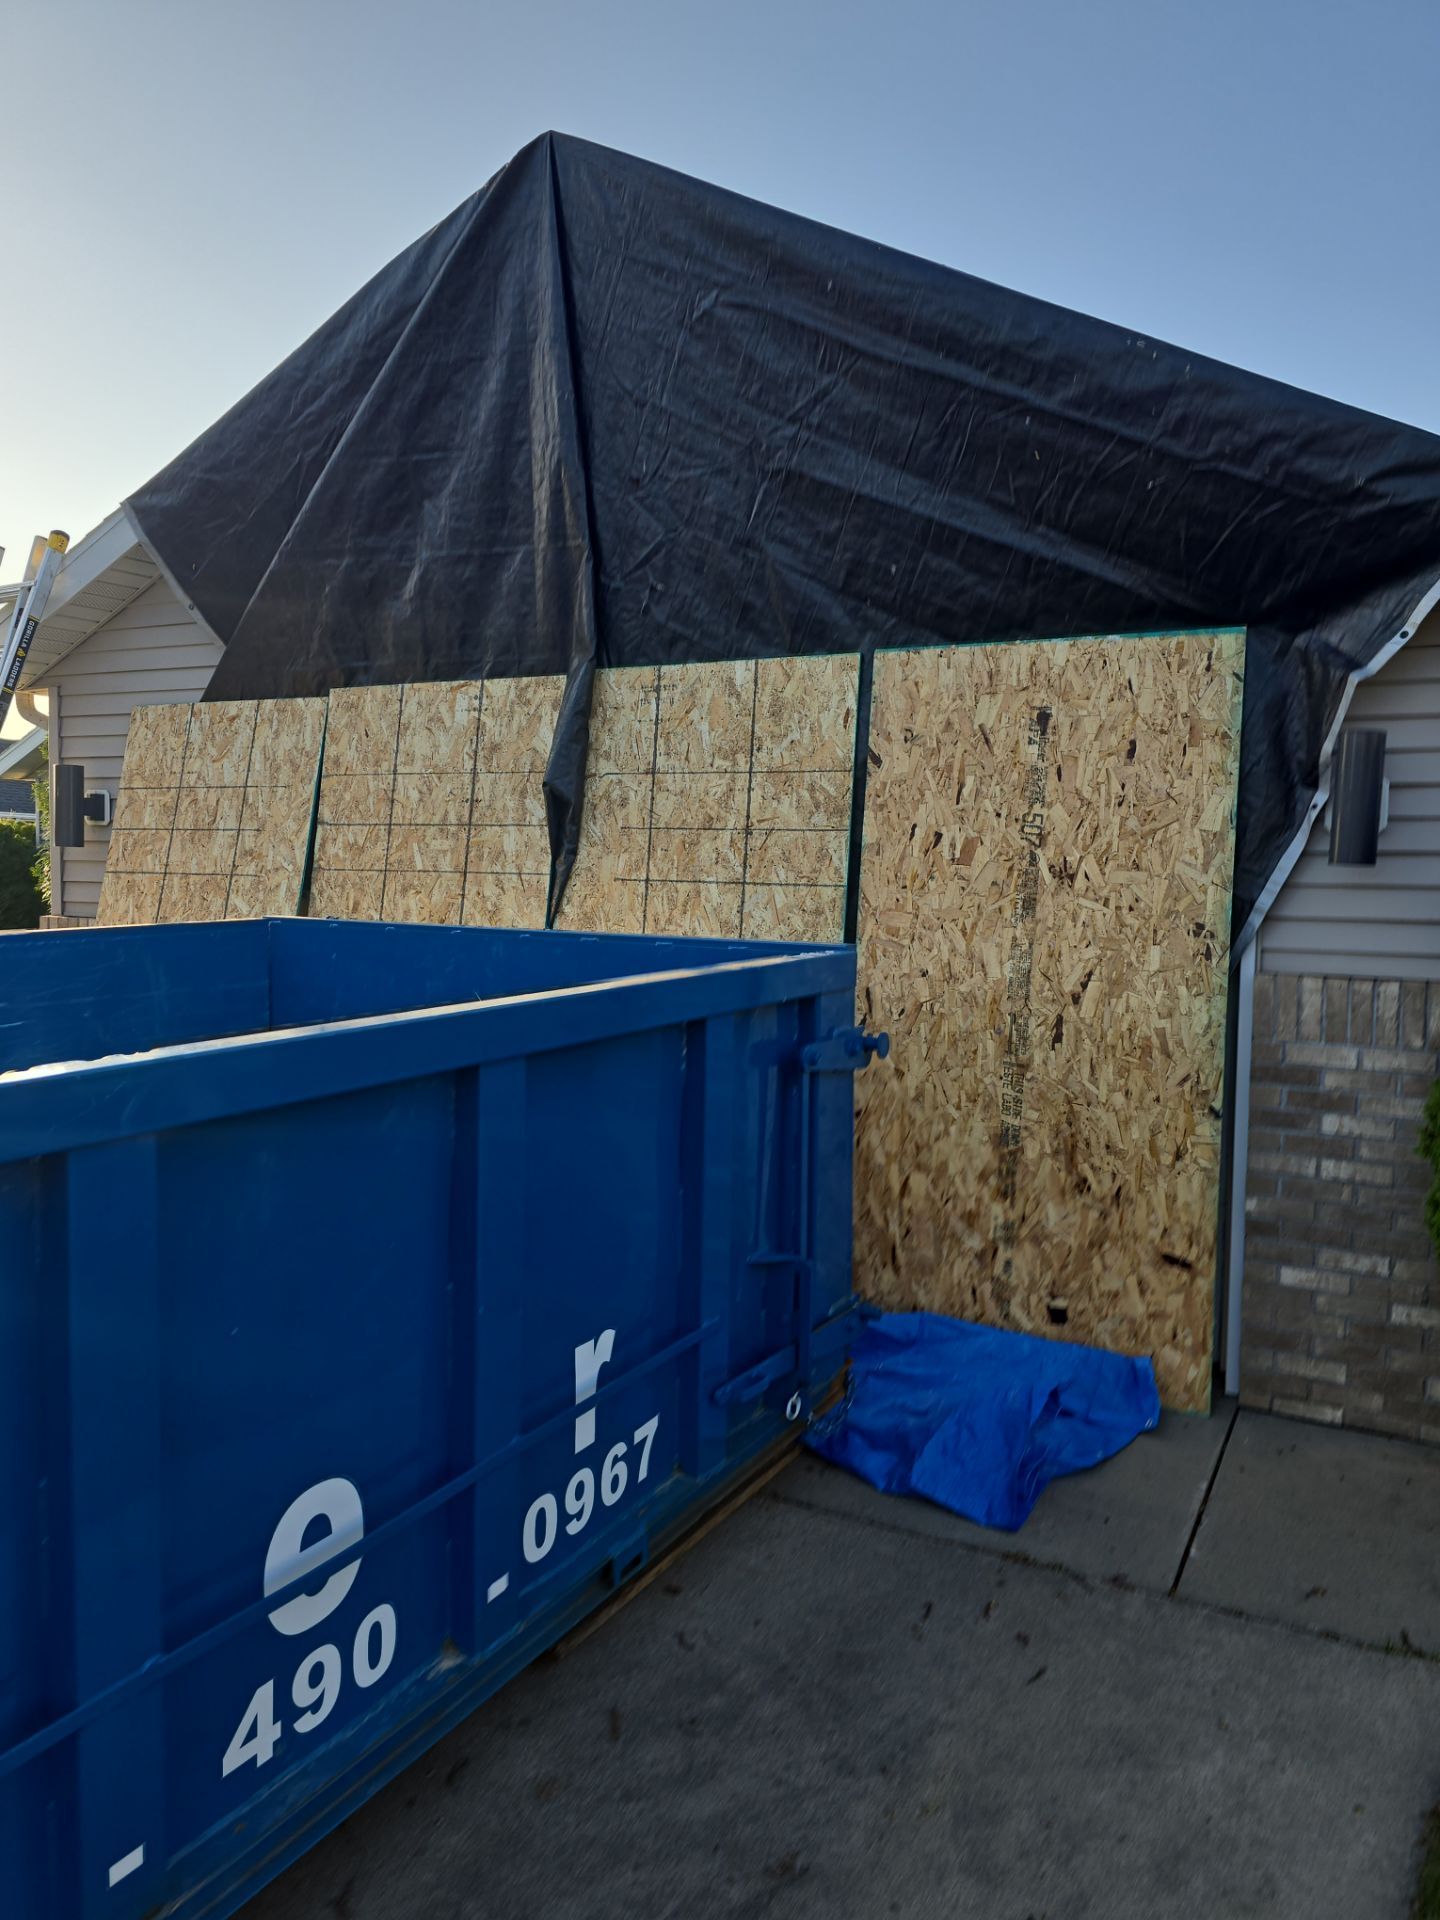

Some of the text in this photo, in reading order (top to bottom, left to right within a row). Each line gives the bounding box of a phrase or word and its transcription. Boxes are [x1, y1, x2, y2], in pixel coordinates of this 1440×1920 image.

[7, 620, 35, 687] GORILLA LADDERS
[1020, 813, 1044, 849] 507
[1002, 1067, 1014, 1088] ESTE
[1012, 1072, 1025, 1095] THIS
[222, 1603, 397, 1778] 490
